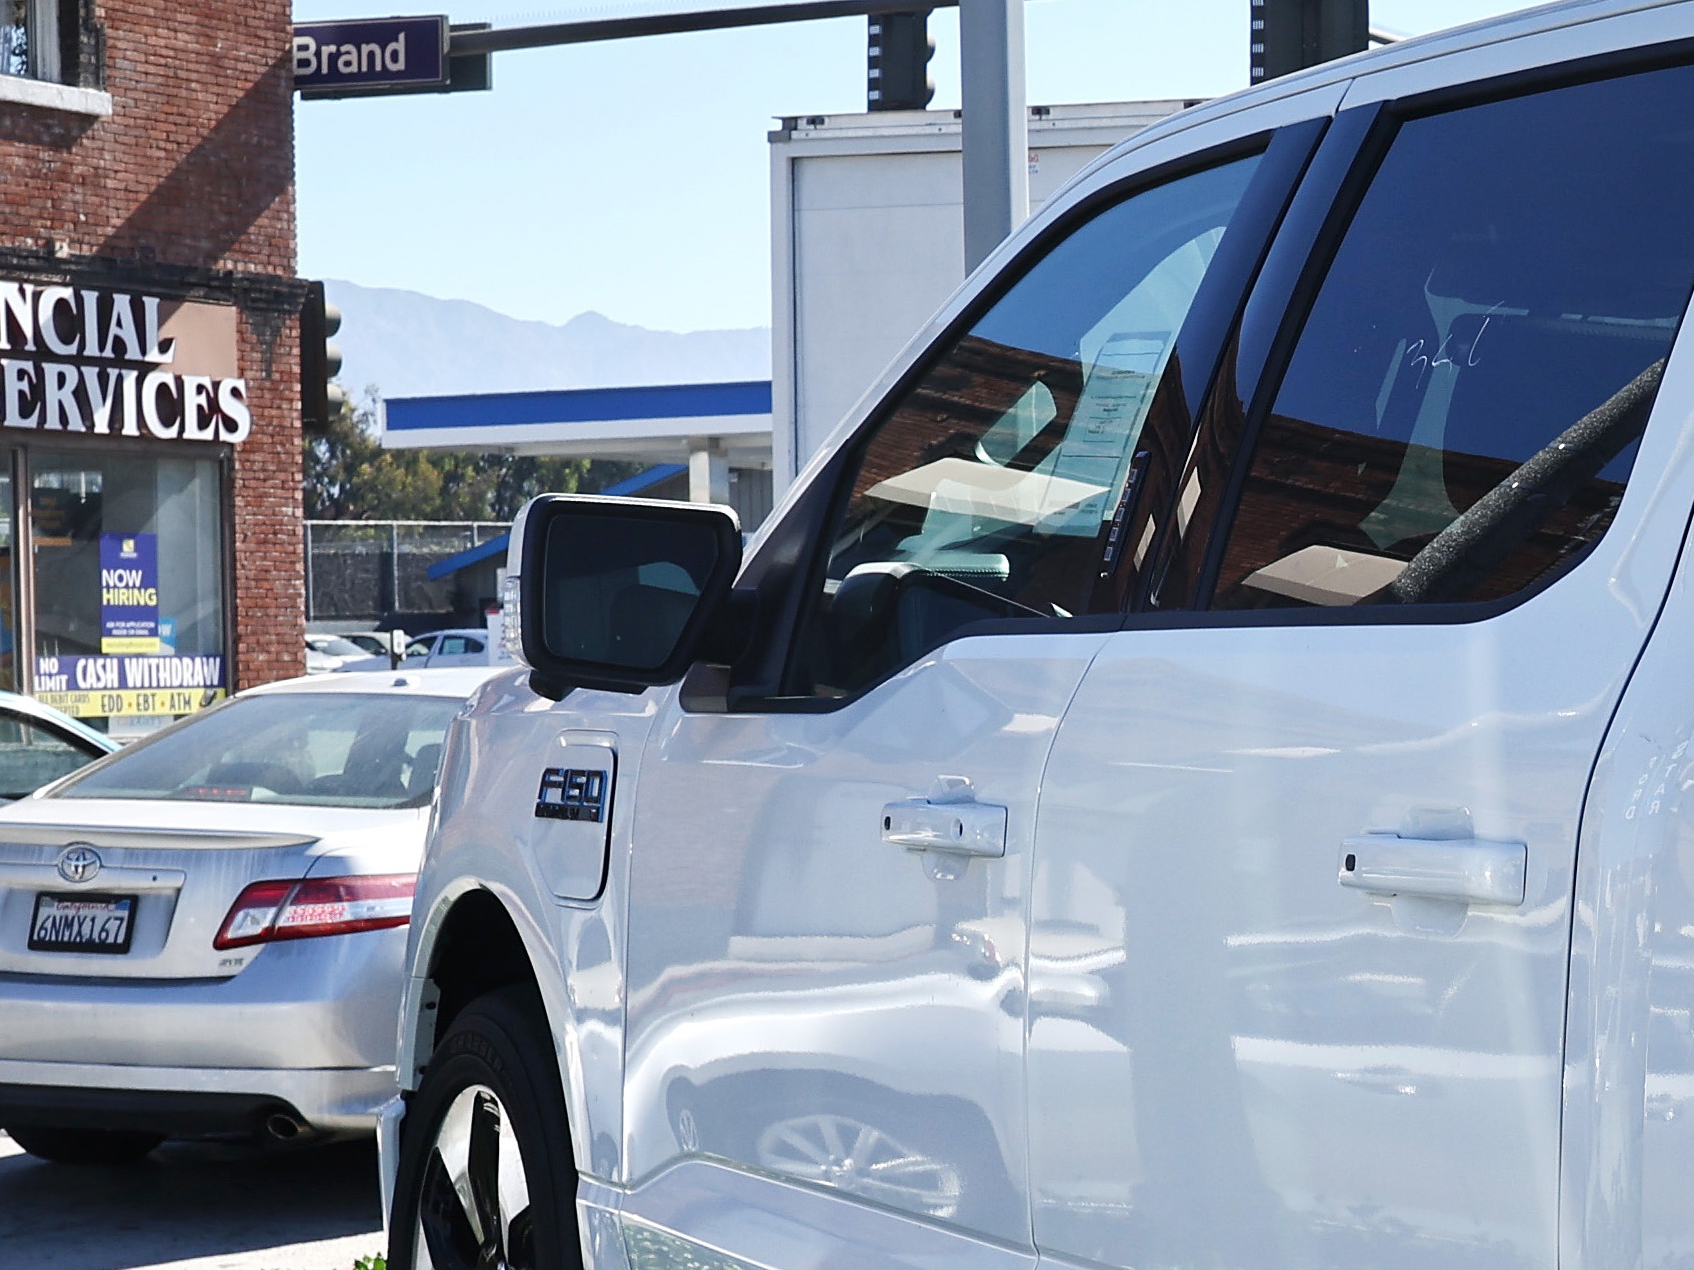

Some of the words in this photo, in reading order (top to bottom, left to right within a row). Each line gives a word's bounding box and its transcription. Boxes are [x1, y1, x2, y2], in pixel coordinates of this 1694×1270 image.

[292, 32, 405, 76] Brand
[102, 569, 142, 587] NOW
[102, 588, 157, 606] HIRING
[39, 657, 59, 675] NO
[76, 657, 119, 689] CASH
[125, 657, 220, 688] WITHDRAW
[34, 675, 68, 691] LIMIT
[101, 695, 123, 713] EDD
[136, 693, 156, 712] EBT
[169, 692, 192, 711] ATM
[37, 914, 125, 944] 6NMX167
